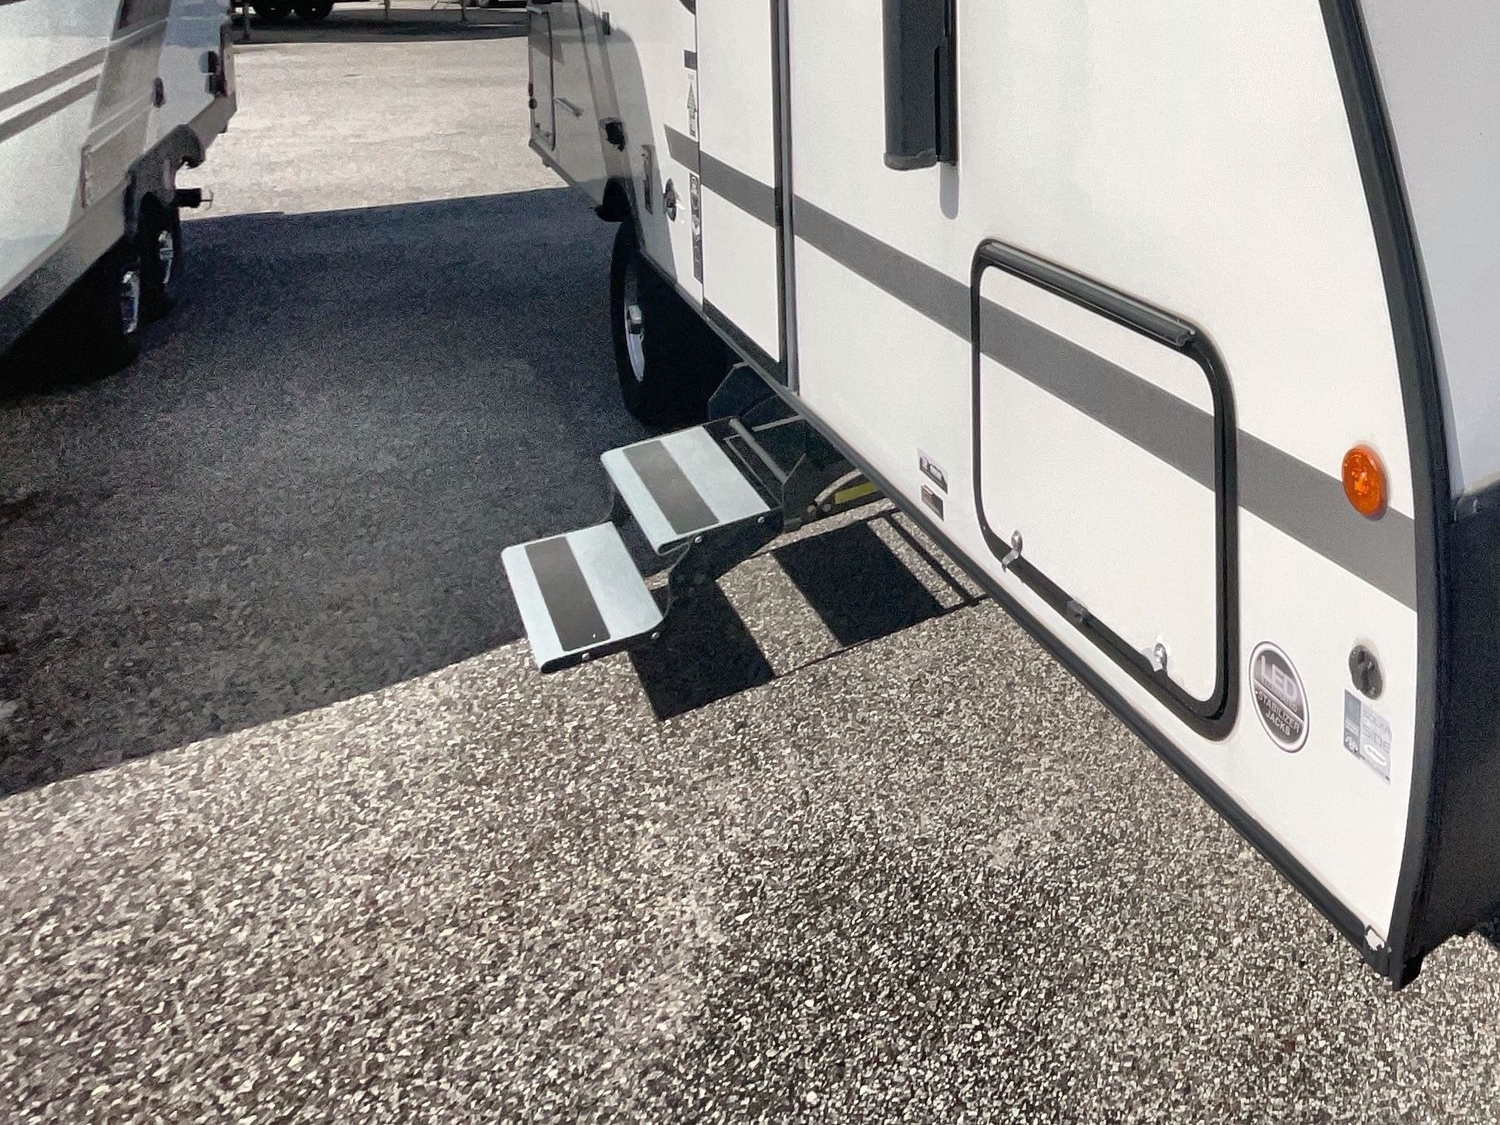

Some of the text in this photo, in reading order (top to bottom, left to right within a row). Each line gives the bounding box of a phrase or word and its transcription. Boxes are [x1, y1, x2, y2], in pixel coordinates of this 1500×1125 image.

[1261, 655, 1297, 701] LED
[1259, 690, 1300, 733] STABILIZER
[1266, 710, 1290, 736] JACKS
[1363, 723, 1390, 754] SIDE
